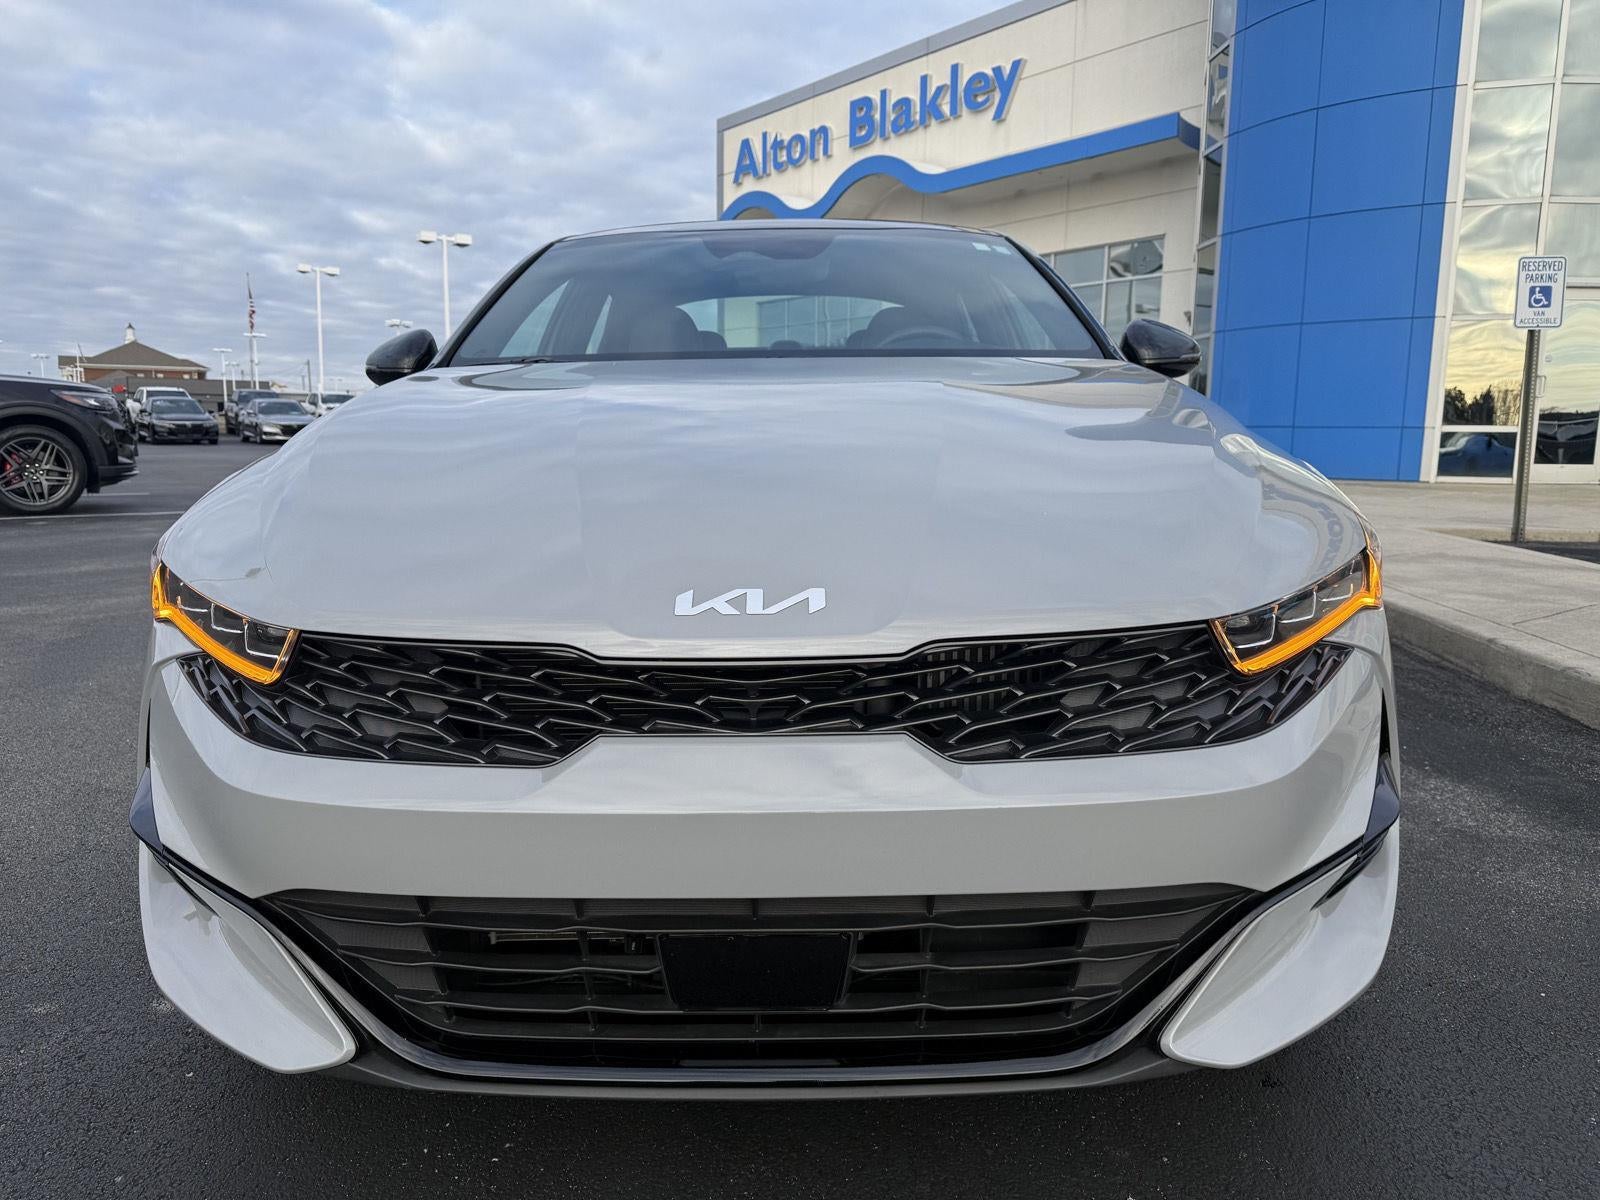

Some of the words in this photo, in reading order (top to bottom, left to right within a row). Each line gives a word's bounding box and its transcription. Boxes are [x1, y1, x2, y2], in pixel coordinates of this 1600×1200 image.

[732, 124, 832, 184] Alton
[848, 57, 1026, 149] Blakley
[1521, 260, 1563, 272] RESERVED
[1525, 273, 1558, 284] PARKING
[674, 588, 826, 616] KIA
